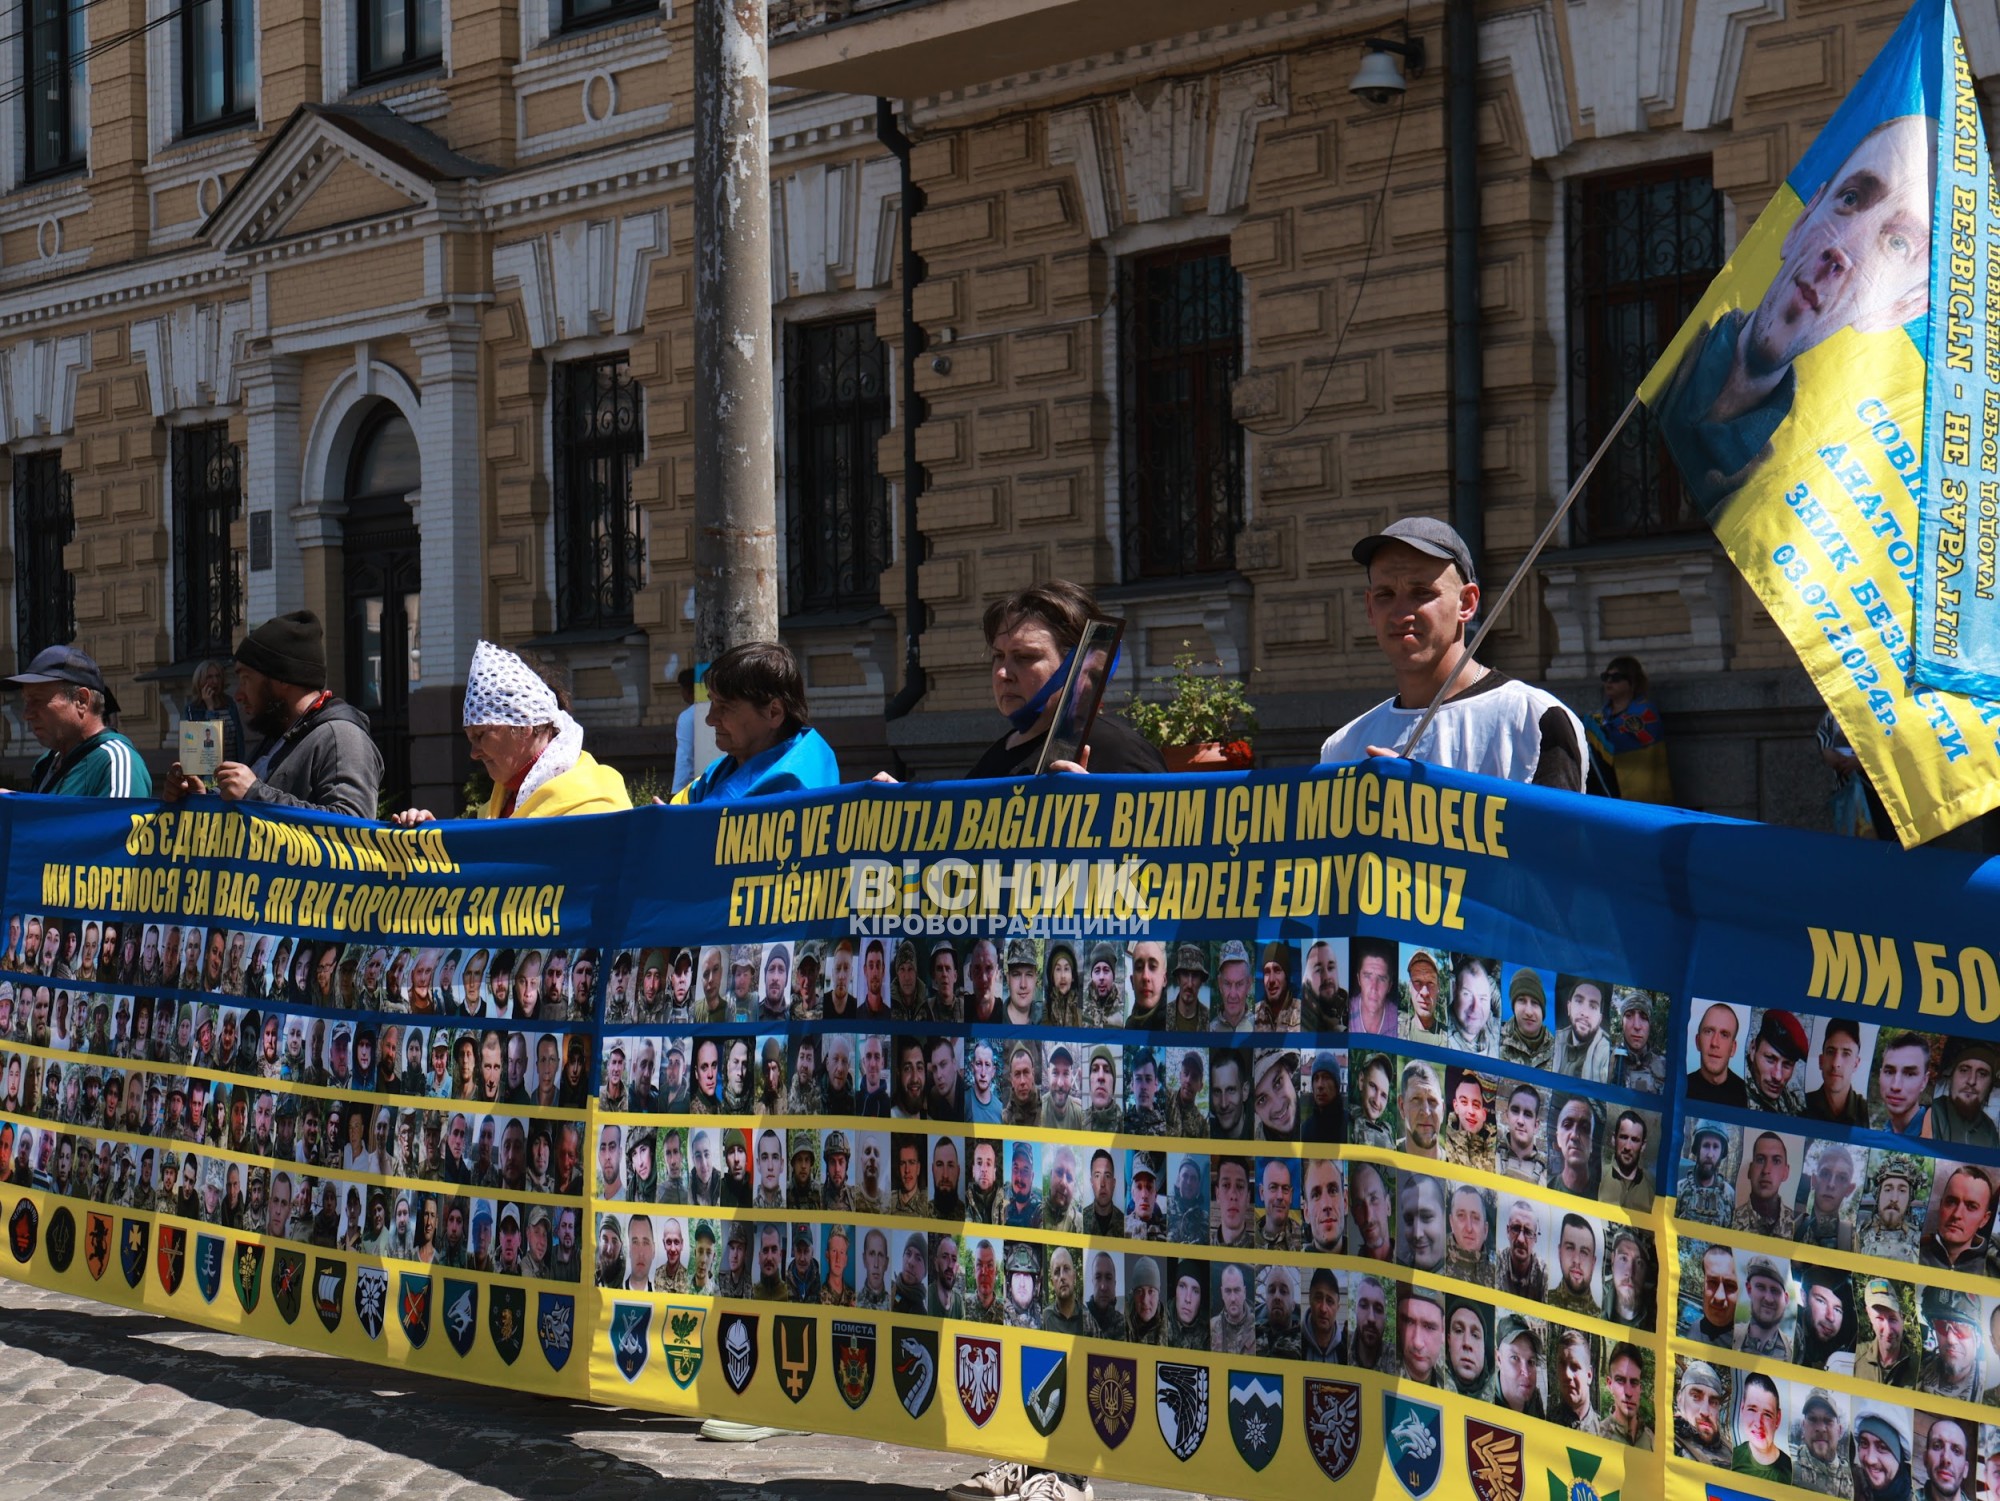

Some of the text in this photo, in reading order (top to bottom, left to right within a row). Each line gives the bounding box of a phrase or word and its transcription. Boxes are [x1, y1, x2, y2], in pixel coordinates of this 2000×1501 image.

[1784, 481, 1860, 573] ЗНИК
[247, 815, 323, 867] ВІРОЮ
[313, 825, 354, 871] ТА
[344, 828, 461, 880] НАДІЄЮ.
[714, 766, 1510, 871] İNANÇ VE UMUTLA BAĞLIYIZ. BIZIM IÇIN MÜCADELE
[42, 863, 565, 937] МИ БОРЕМОСЯ ЗА ВАС, ЯК ВИ БОРОЛИСЯ ЗА НАС!
[1084, 853, 1265, 921] MÜCADELE
[1269, 851, 1467, 931] EDIYORUZ
[1806, 926, 1903, 1010] МИ
[834, 1323, 874, 1335] ПОМСТА
